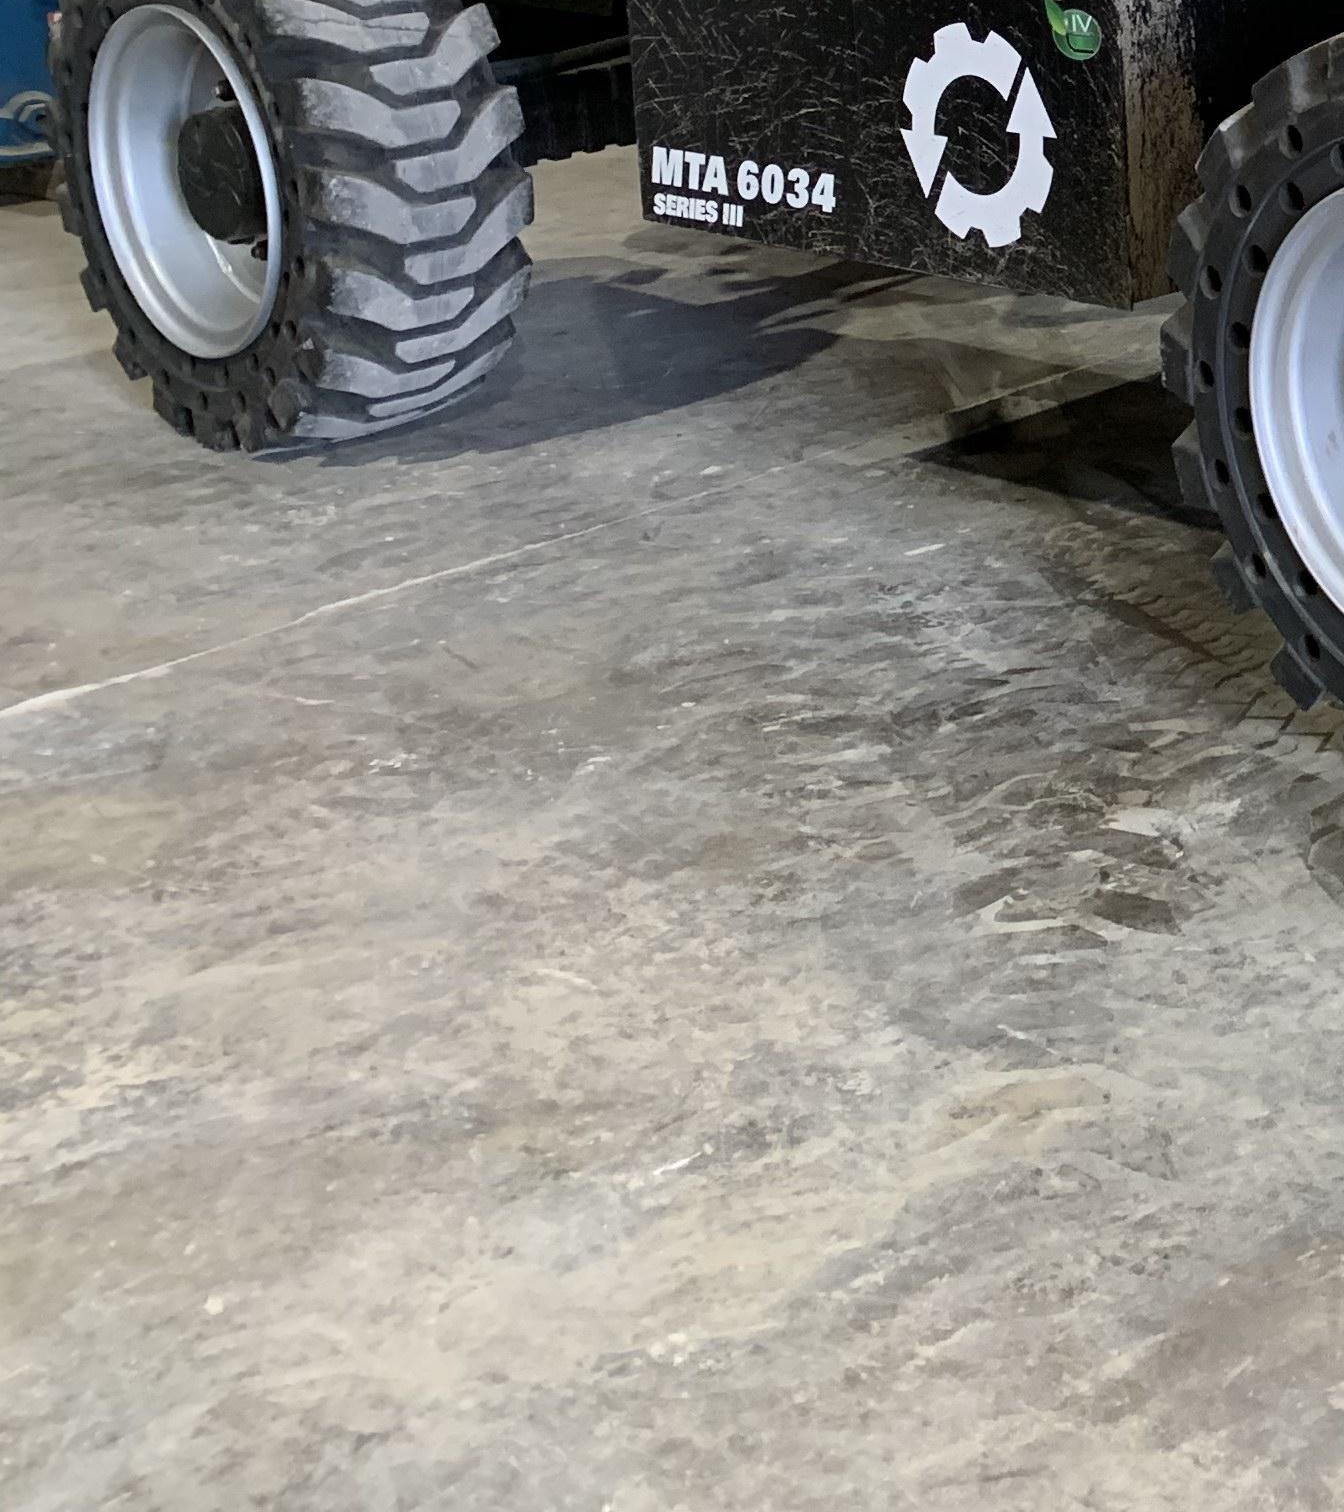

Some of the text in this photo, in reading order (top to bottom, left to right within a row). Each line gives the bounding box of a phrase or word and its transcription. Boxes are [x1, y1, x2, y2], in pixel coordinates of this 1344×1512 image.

[1071, 13, 1093, 33] IV
[651, 145, 837, 214] MTA 6034
[652, 192, 745, 228] SERIES III
